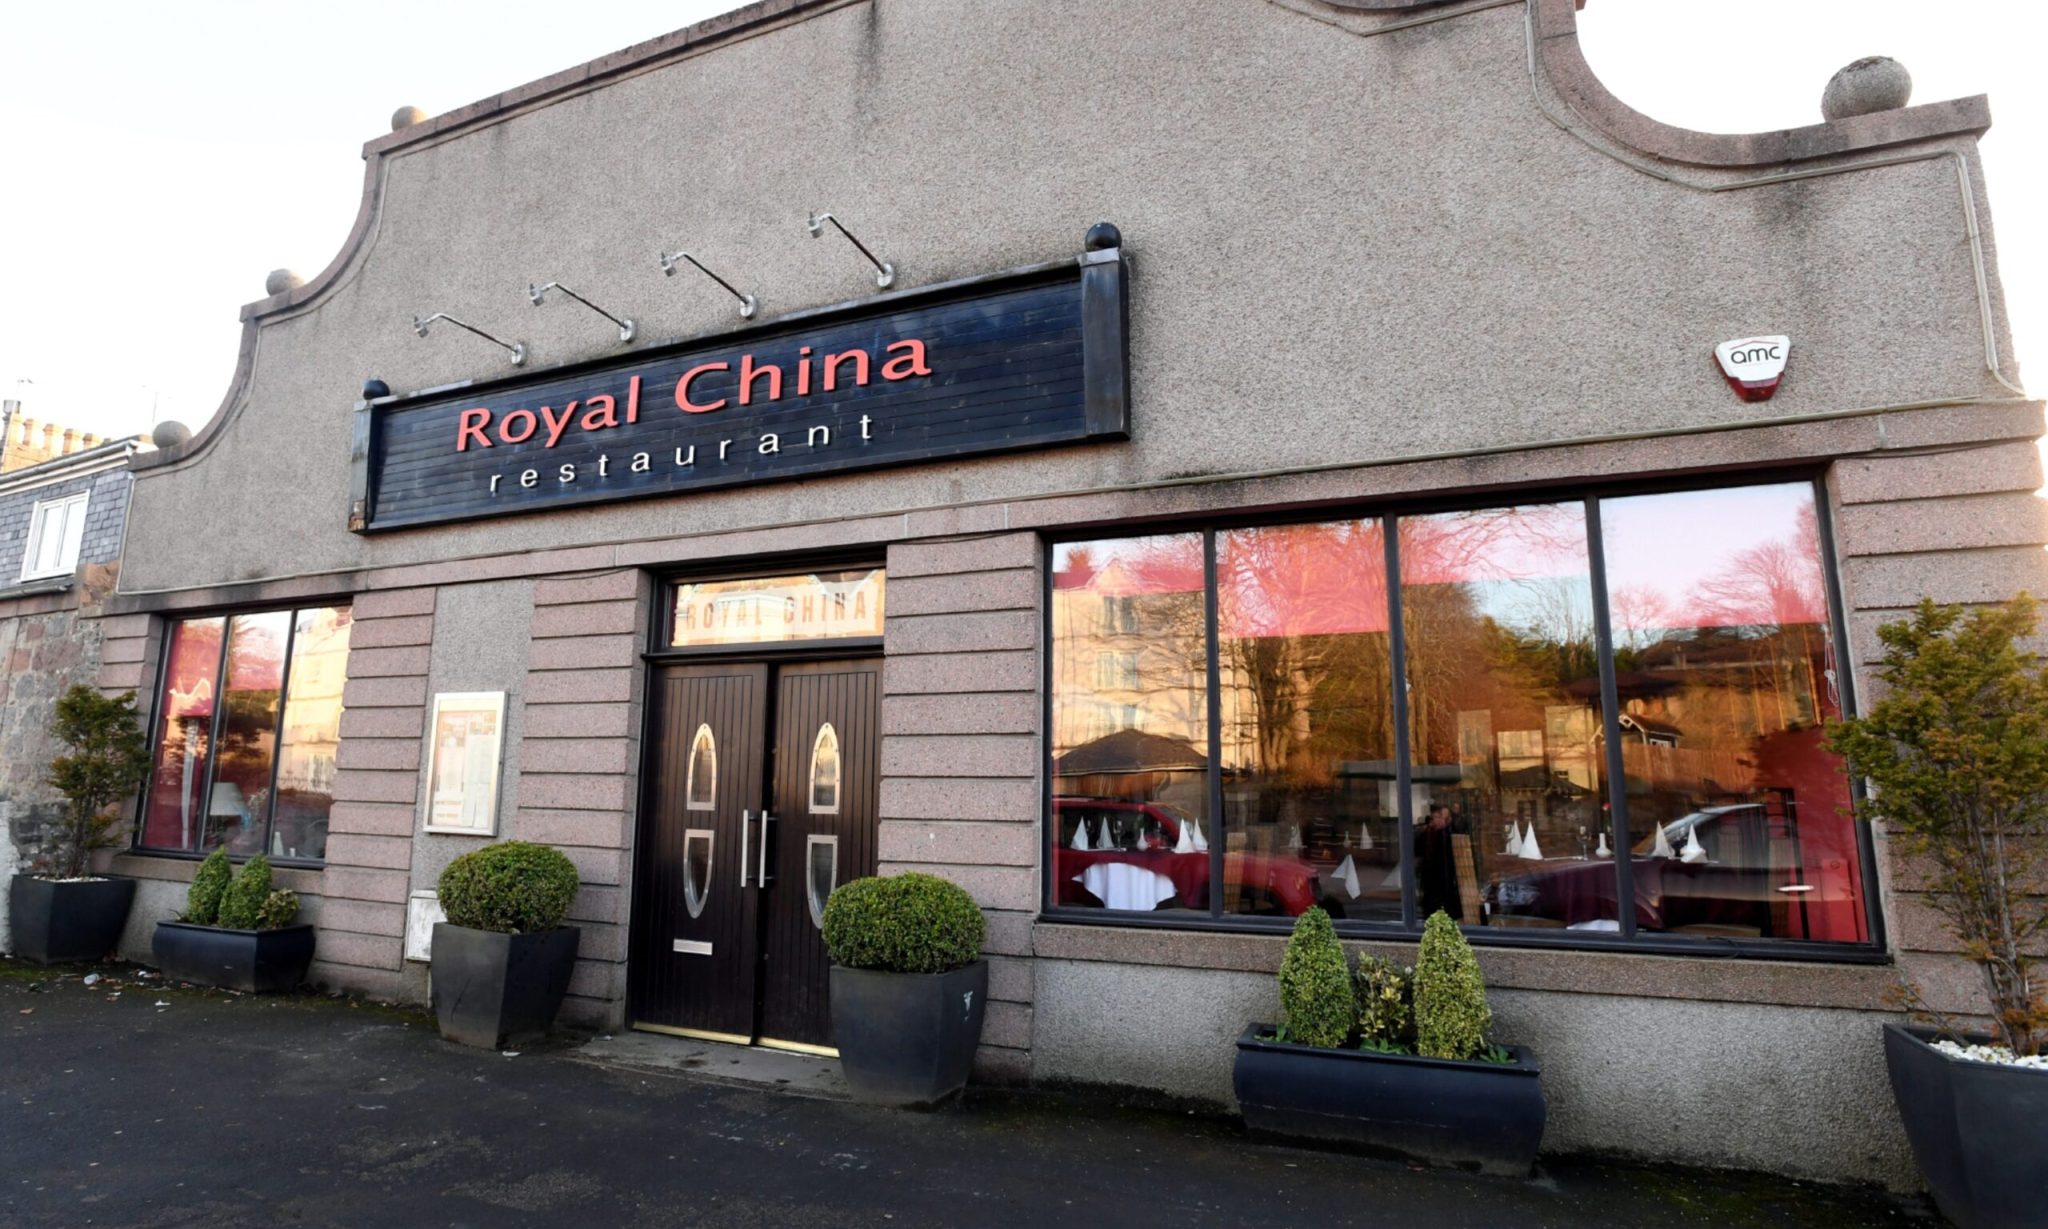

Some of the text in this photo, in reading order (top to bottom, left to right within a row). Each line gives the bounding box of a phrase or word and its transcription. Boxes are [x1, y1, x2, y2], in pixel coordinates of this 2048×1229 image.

[1730, 345, 1781, 364] amc
[456, 338, 932, 451] Royal China
[489, 414, 873, 493] restaurant
[686, 591, 867, 630] ROYAL CHINA
